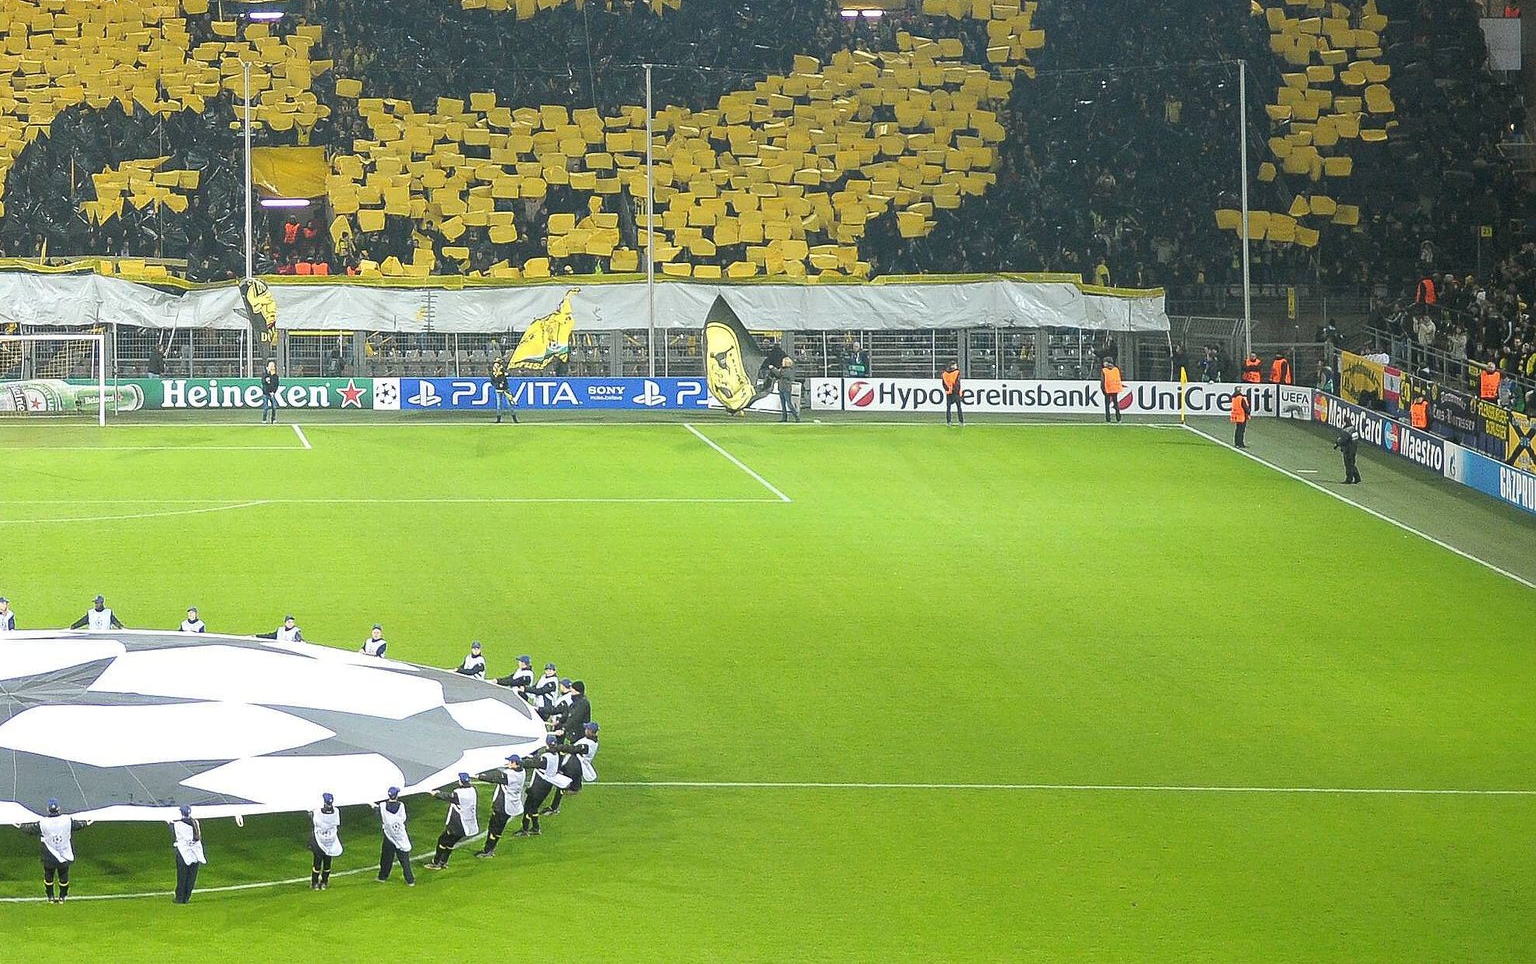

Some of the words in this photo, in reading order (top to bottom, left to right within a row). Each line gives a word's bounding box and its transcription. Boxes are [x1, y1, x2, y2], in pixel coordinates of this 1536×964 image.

[588, 386, 626, 395] SONY
[879, 383, 1100, 410] Hypoereinsbank
[1281, 392, 1310, 404] UEFA
[1400, 427, 1443, 471] Maestro
[1499, 466, 1536, 513] GAZPRO
